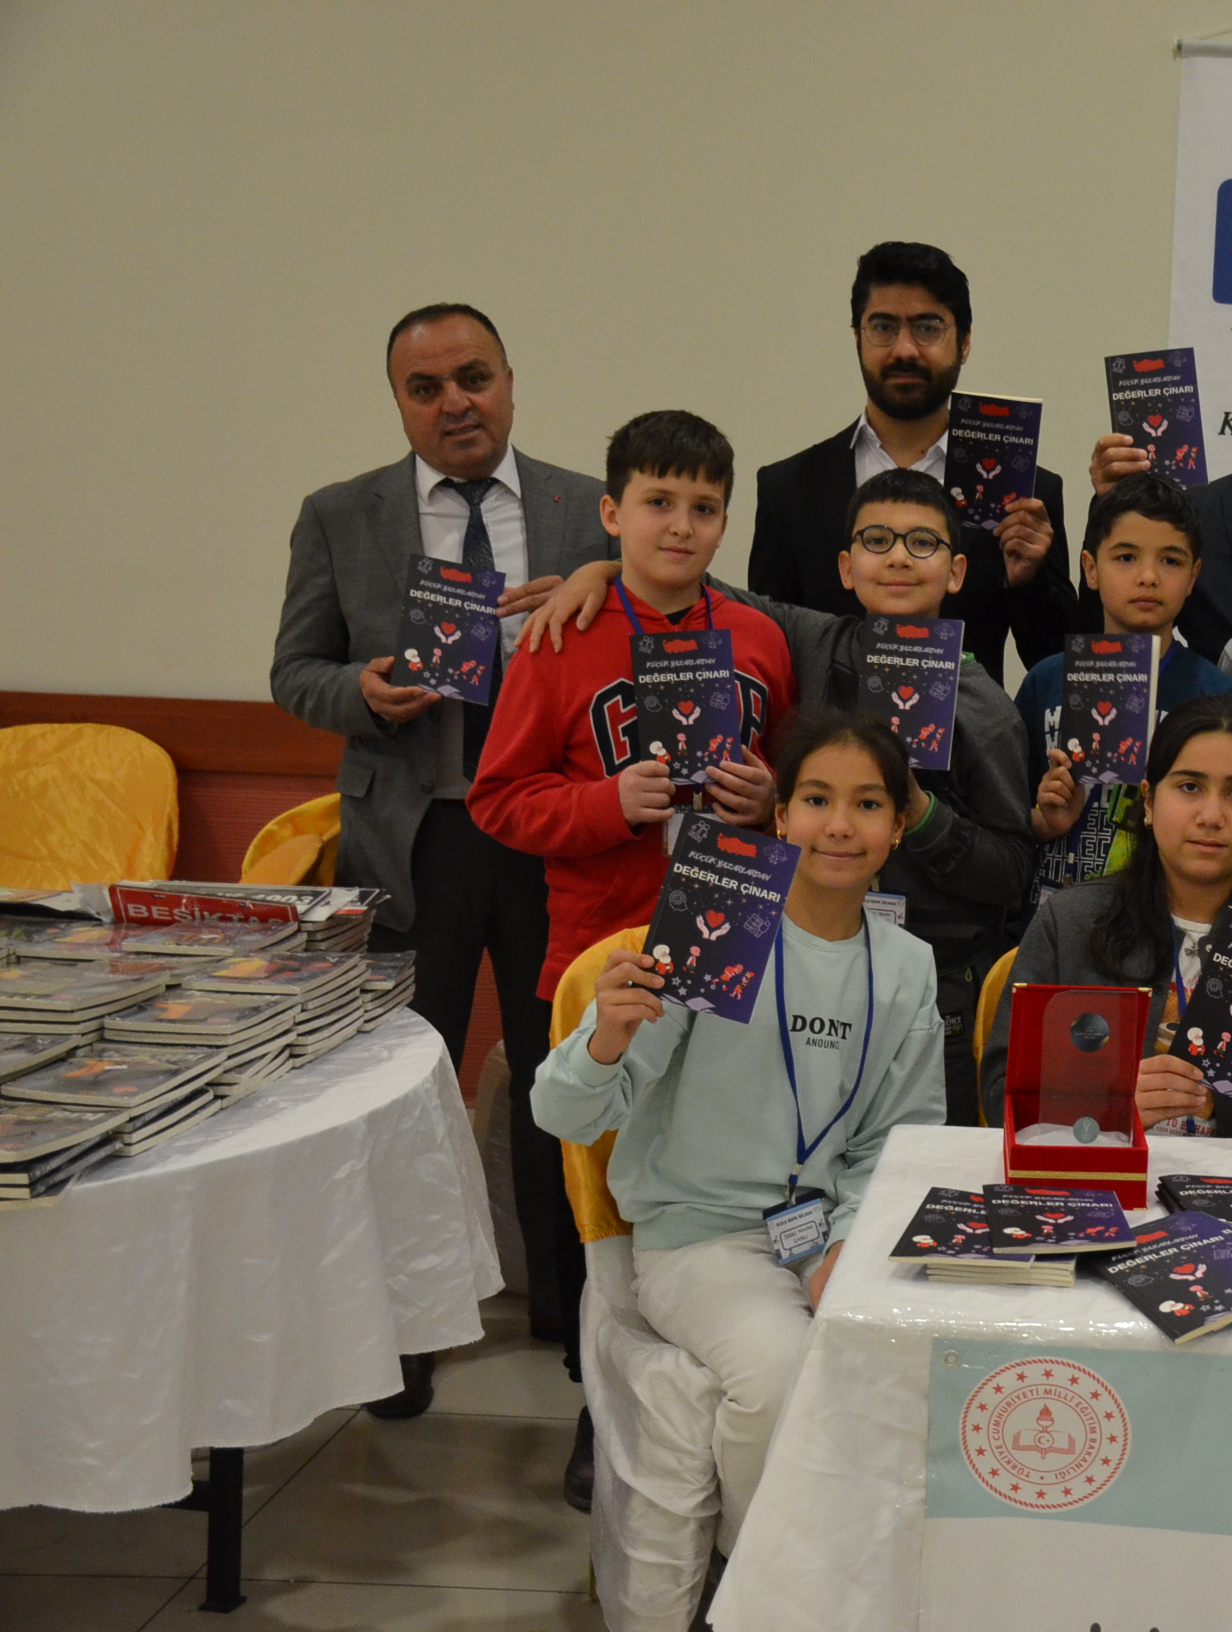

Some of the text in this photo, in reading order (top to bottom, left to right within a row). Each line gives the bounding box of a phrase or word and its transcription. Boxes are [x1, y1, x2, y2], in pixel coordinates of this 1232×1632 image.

[674, 863, 738, 889] DEĞERLER
[790, 1015, 852, 1039] DONT
[993, 1387, 1097, 1480] TÜRKİYE CUMHURİYETİ MİLLİ EĞİTİM BAKANLIĞI
